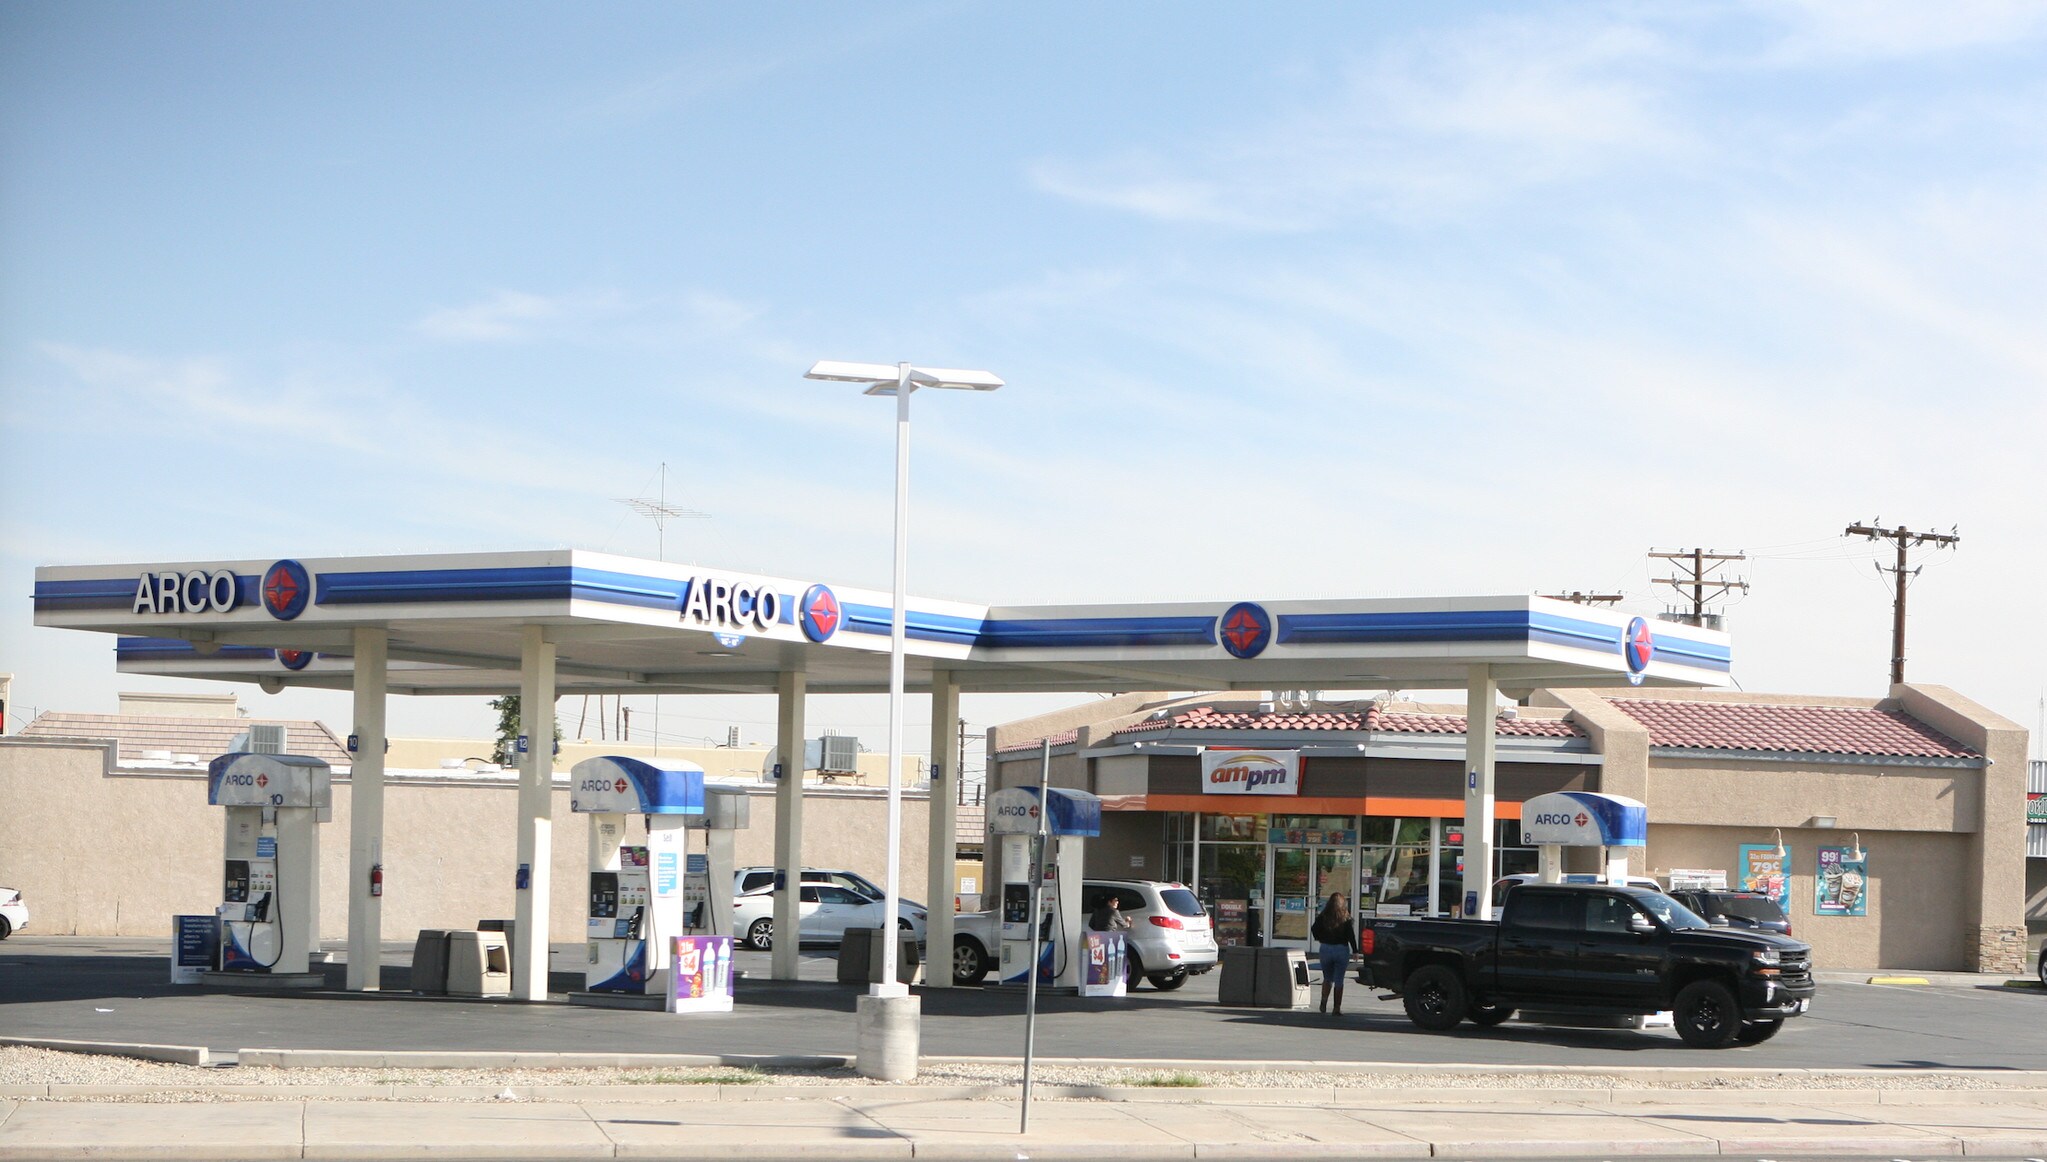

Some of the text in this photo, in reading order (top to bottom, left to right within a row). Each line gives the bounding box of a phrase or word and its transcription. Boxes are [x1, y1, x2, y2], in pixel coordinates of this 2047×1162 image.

[132, 569, 236, 615] ARCO
[684, 576, 781, 629] ARCO
[349, 737, 357, 747] 10
[519, 738, 528, 749] 12
[225, 774, 254, 787] ARCO
[1210, 766, 1287, 791] ampm
[581, 780, 612, 792] ARCO
[270, 794, 283, 805] 10
[998, 806, 1026, 817] ARCO
[704, 819, 711, 829] 4
[1535, 814, 1571, 825] ARCO
[989, 823, 995, 834] 6
[1524, 832, 1532, 844] 8
[1752, 861, 1780, 873] 79¢
[1093, 949, 1103, 962] $4
[684, 955, 696, 971] $4
